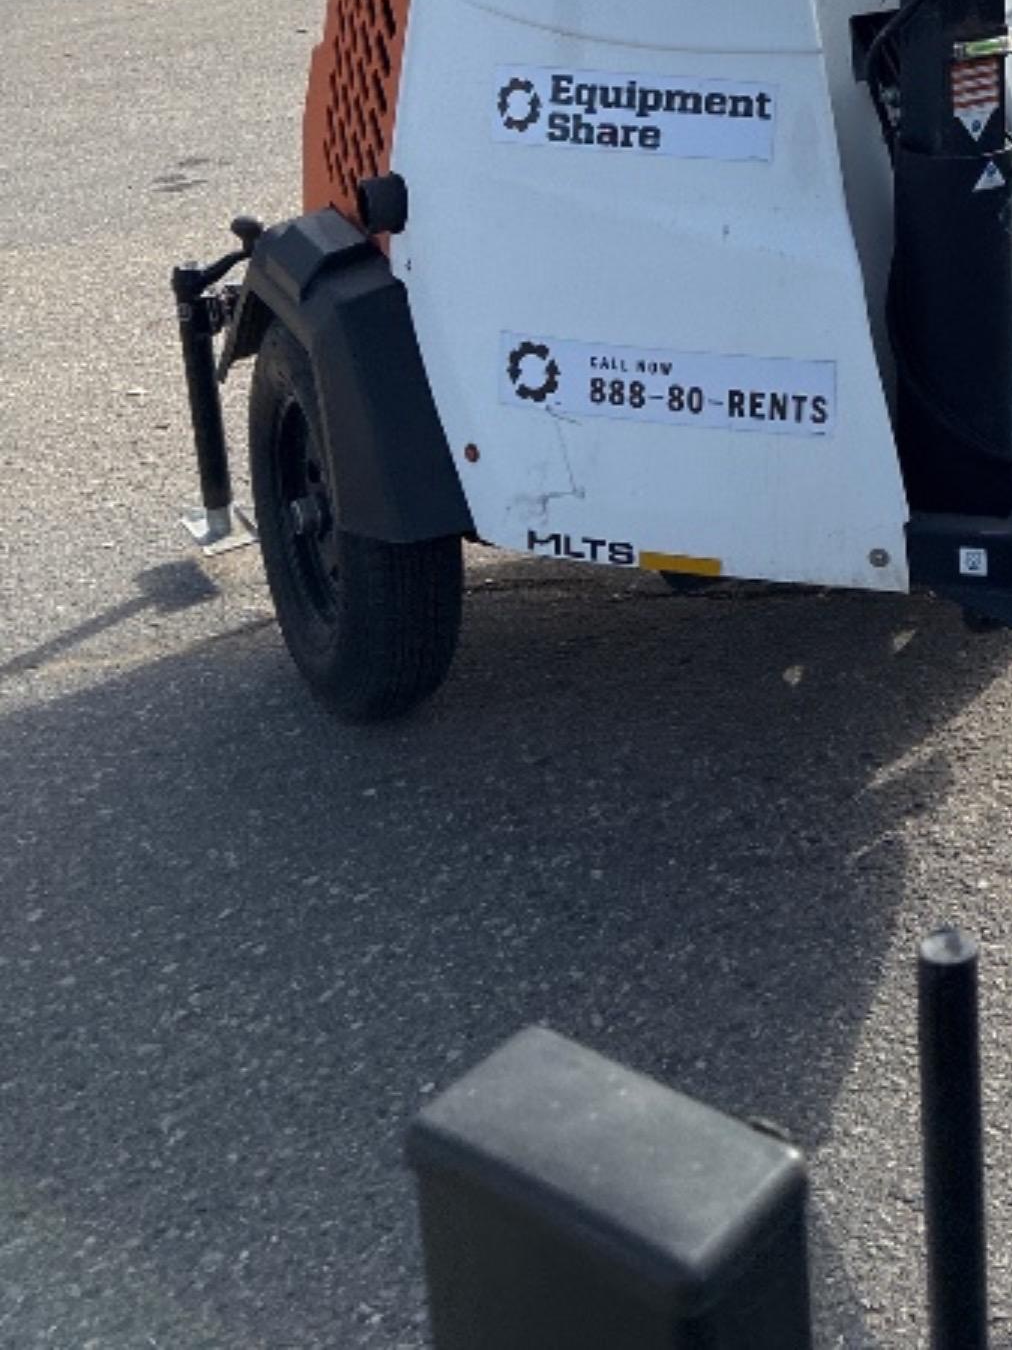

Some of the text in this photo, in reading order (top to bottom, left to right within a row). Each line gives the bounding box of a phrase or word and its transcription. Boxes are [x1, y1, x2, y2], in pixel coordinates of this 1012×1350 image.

[549, 74, 772, 121] Equipment
[546, 113, 662, 150] Share
[590, 356, 673, 376] CALL NOW
[590, 377, 829, 424] 888-80-RENTS
[527, 529, 635, 566] MLTS
